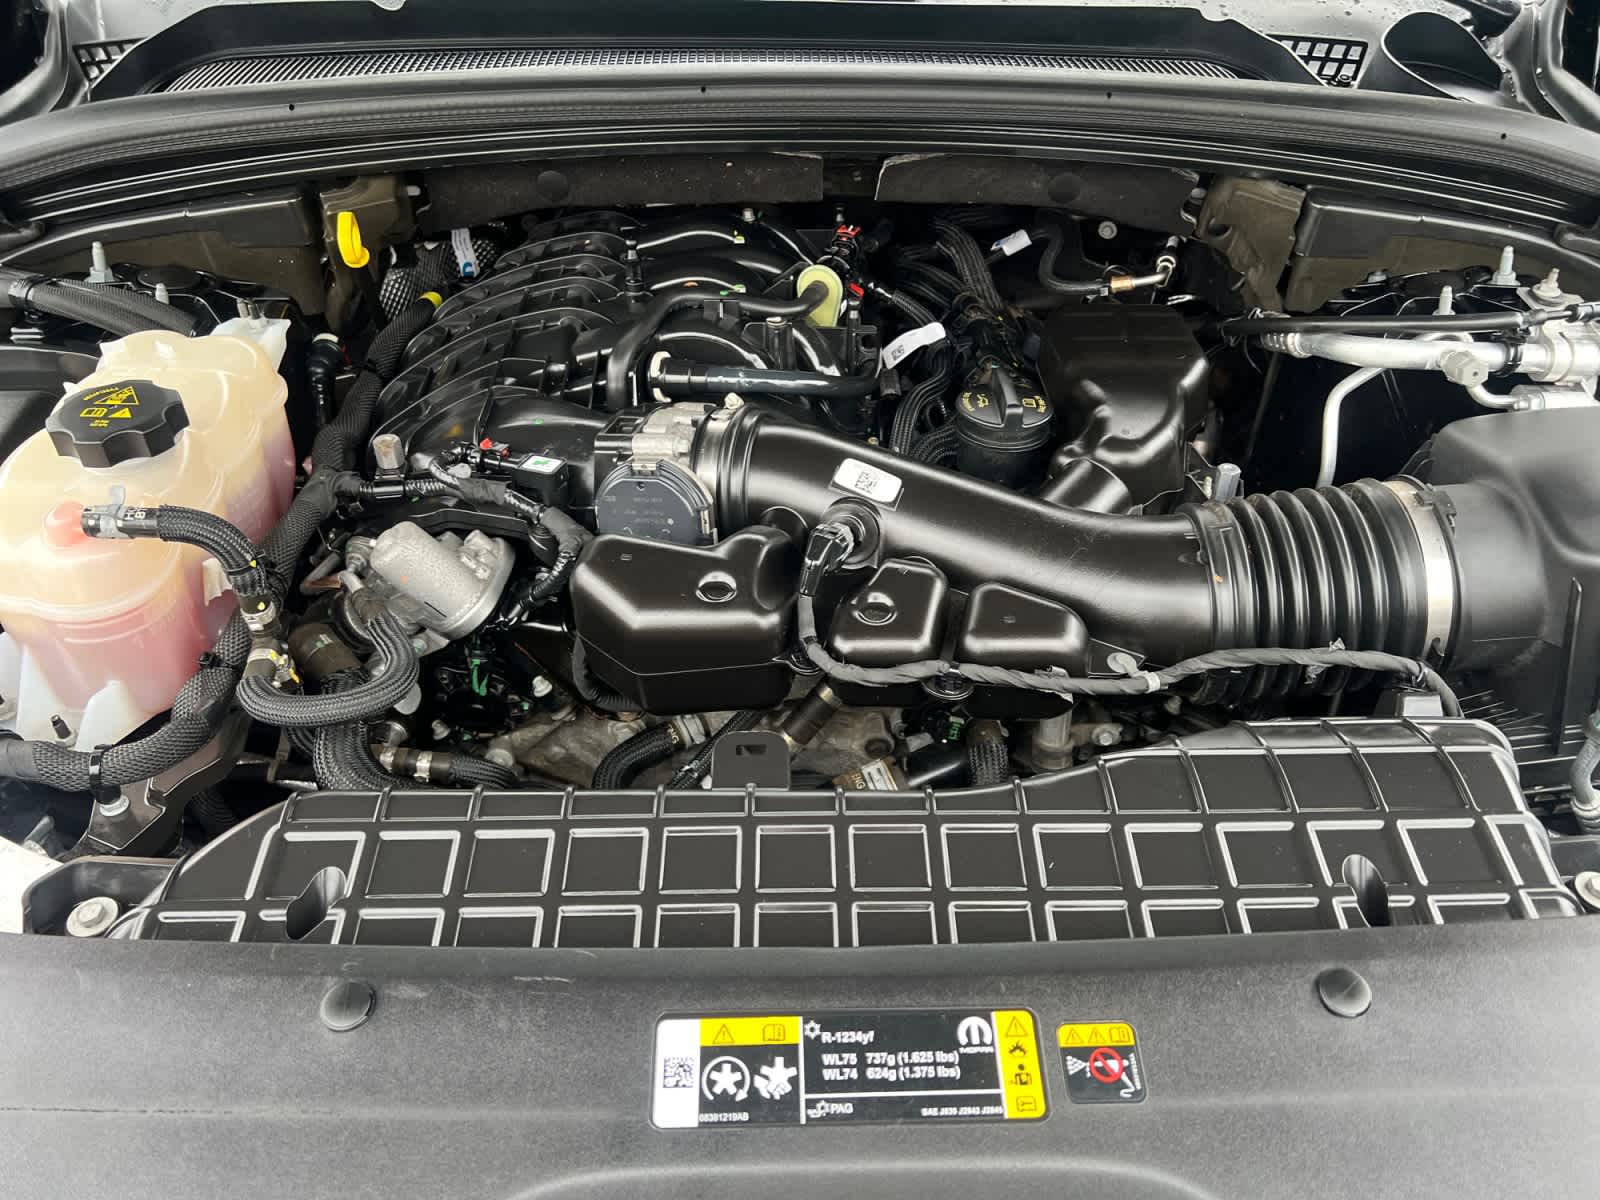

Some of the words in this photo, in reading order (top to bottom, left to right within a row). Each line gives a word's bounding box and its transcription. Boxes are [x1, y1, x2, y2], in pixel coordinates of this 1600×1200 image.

[821, 1031, 875, 1045] R-1234yf
[822, 1053, 858, 1066] WL75
[865, 1052, 897, 1066] 737g
[897, 1052, 935, 1065] (1.625
[935, 1051, 960, 1065] lbs)
[822, 1067, 858, 1081] WL74
[866, 1067, 898, 1082] 624g
[898, 1067, 936, 1081] (1.375
[936, 1066, 961, 1080] lbs)
[831, 1103, 854, 1115] PAG
[921, 1107, 939, 1117] SAE
